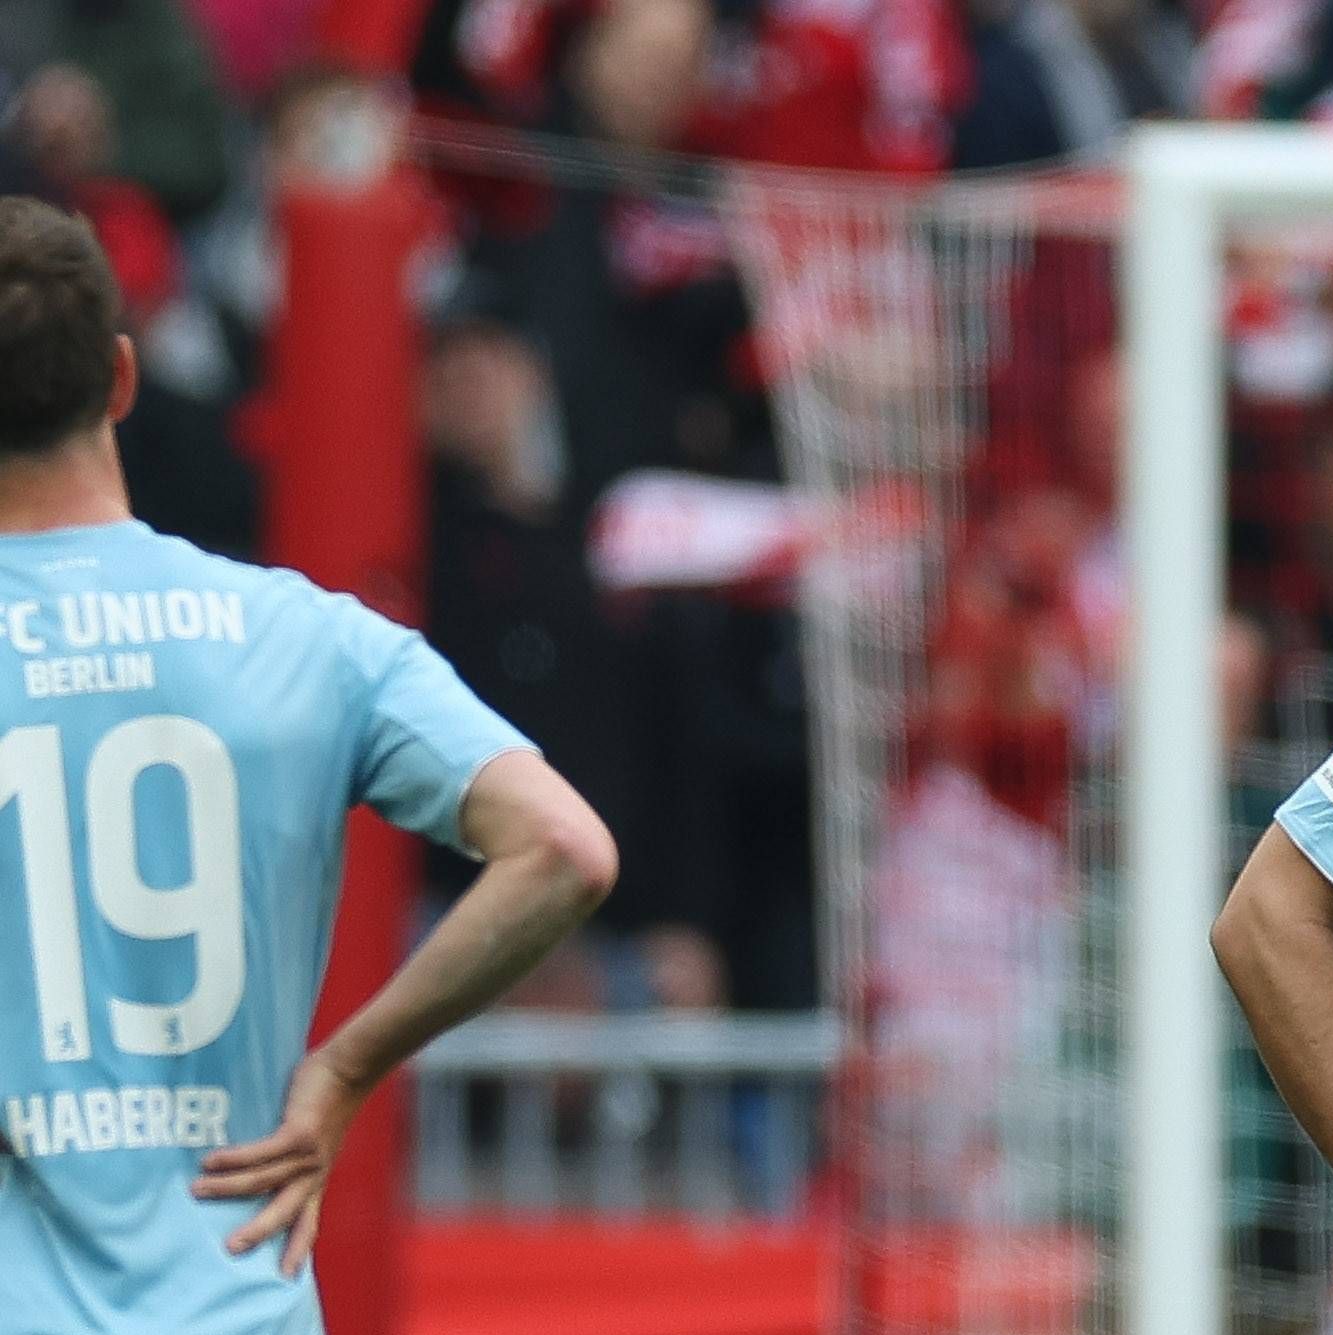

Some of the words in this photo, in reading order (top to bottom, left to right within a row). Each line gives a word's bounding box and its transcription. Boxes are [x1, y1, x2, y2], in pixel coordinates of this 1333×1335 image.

[0, 600, 47, 653] C
[57, 587, 246, 645] UNION
[24, 651, 156, 699] BERLIN
[0, 714, 245, 1063] 19
[5, 1084, 230, 1159] HABERER
